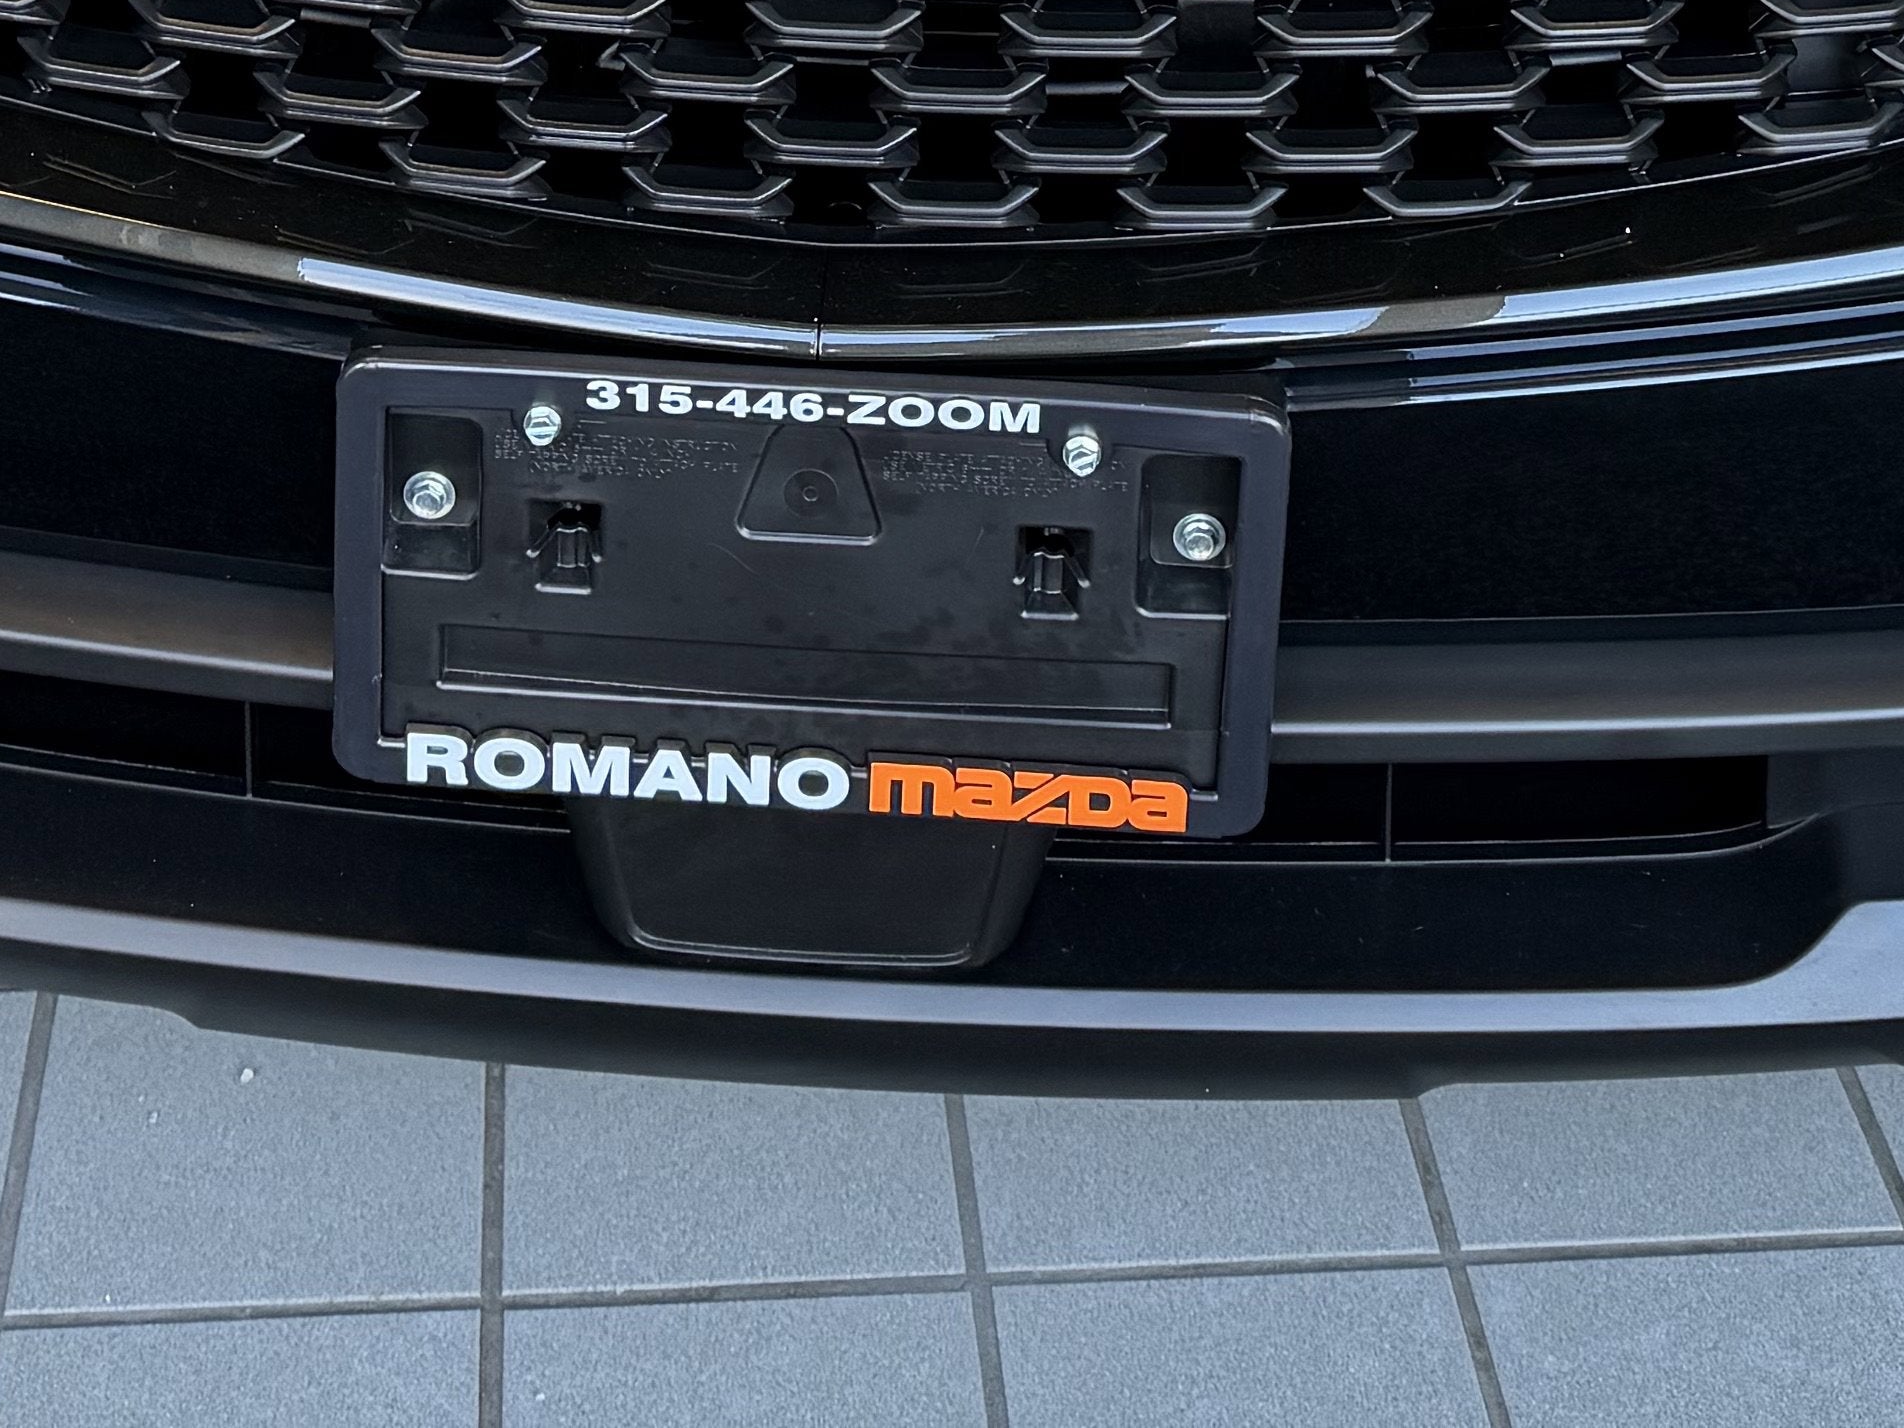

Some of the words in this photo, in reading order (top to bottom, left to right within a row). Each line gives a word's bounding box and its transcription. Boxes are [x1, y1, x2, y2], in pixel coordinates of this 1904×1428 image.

[585, 379, 1041, 434] 315-446-ZOOM
[405, 731, 851, 811] ROMANO
[868, 761, 1189, 833] mazda
